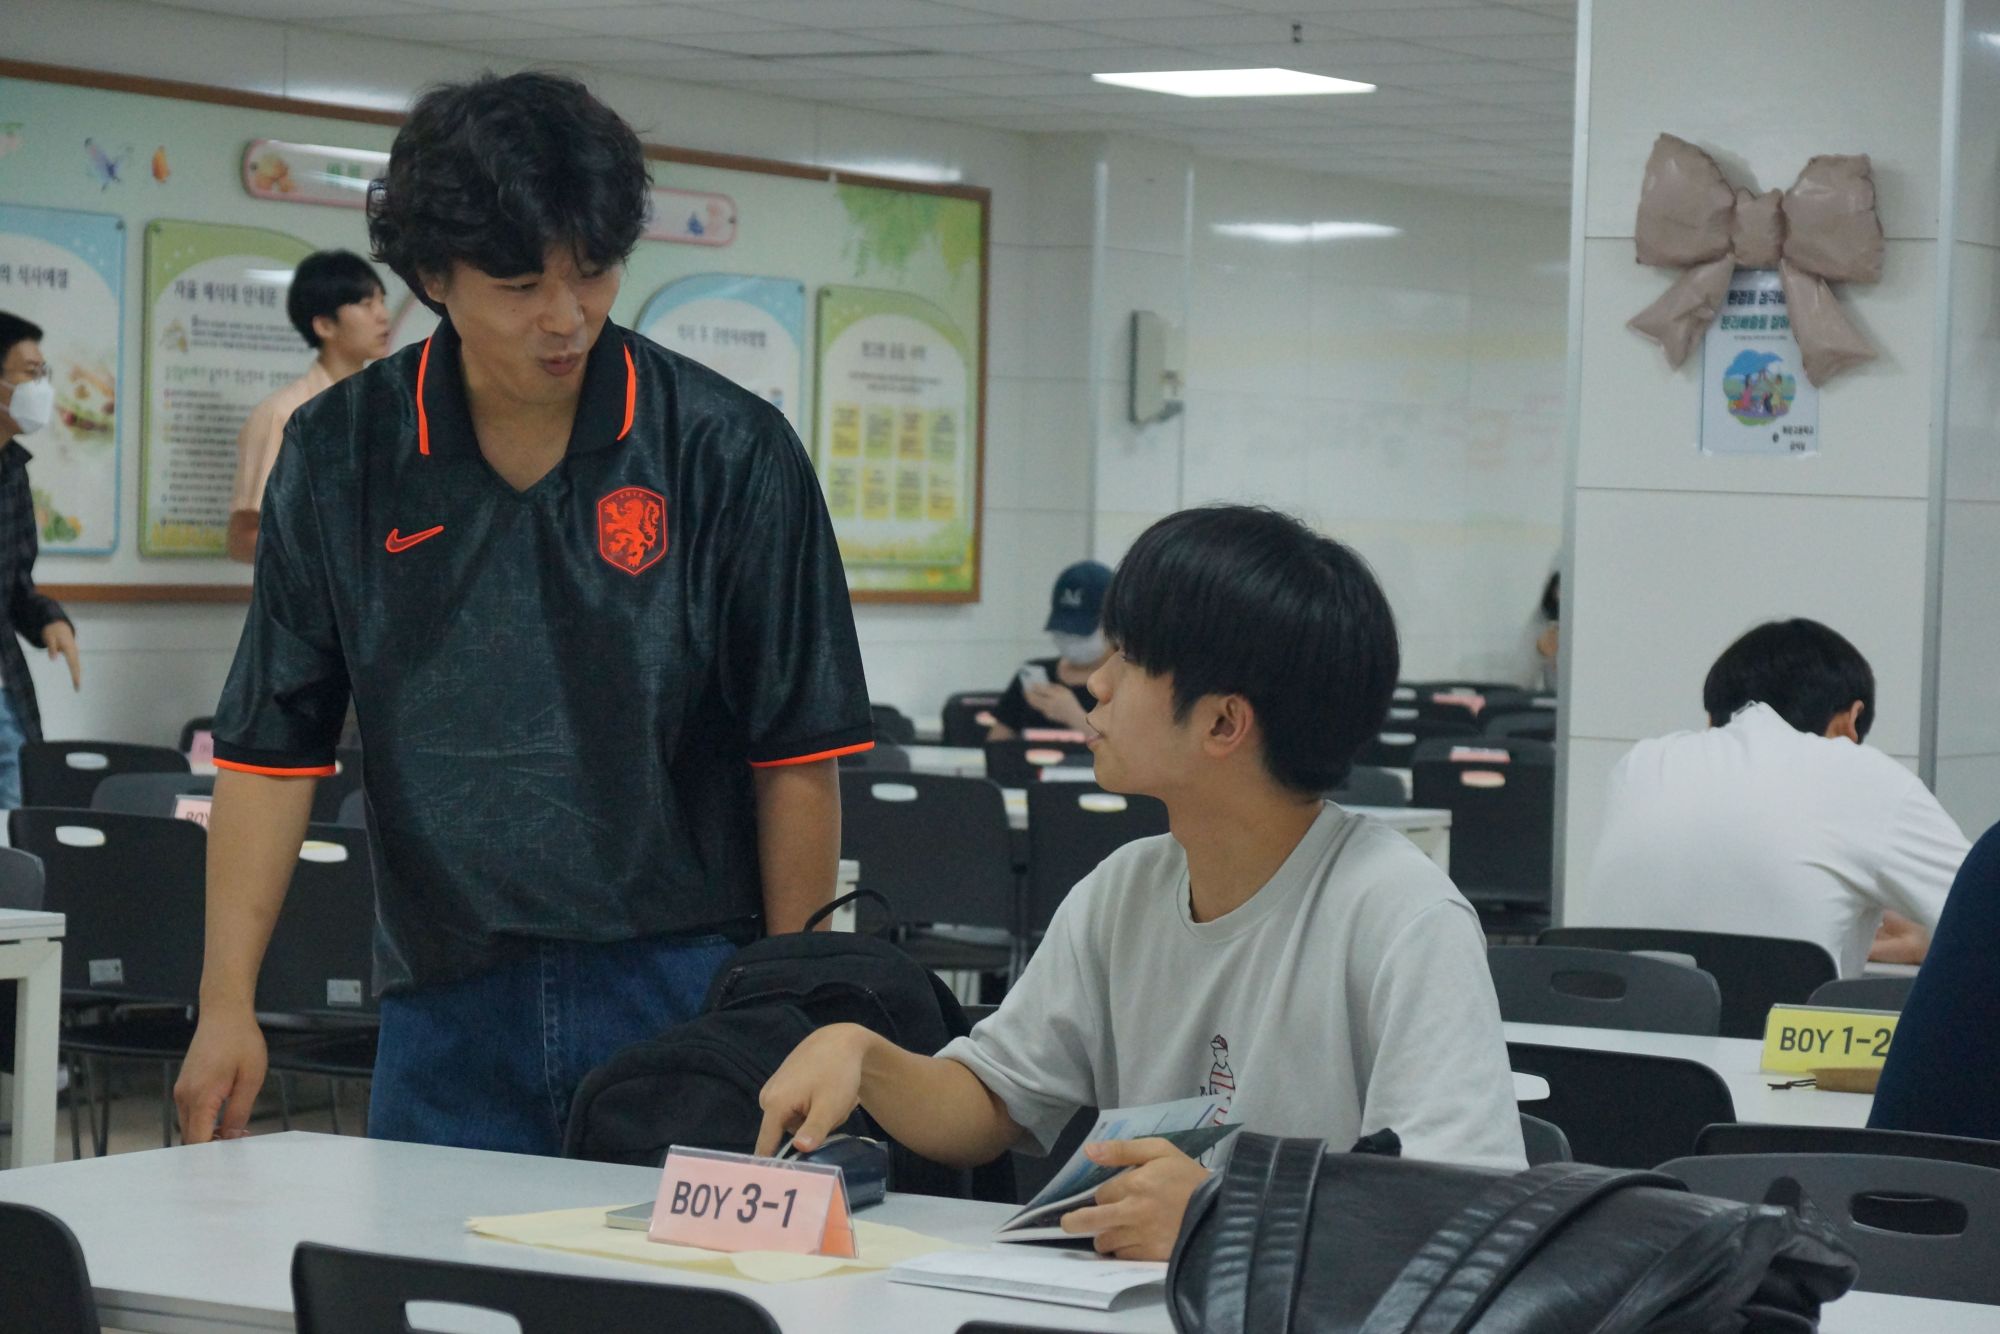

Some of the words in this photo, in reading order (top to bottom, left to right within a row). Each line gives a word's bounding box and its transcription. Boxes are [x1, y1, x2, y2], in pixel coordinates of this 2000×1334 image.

[1780, 1026, 1834, 1053] BOY
[1842, 1026, 1892, 1057] 1-2
[670, 1181, 733, 1219] BOY
[736, 1182, 798, 1228] 3-1
